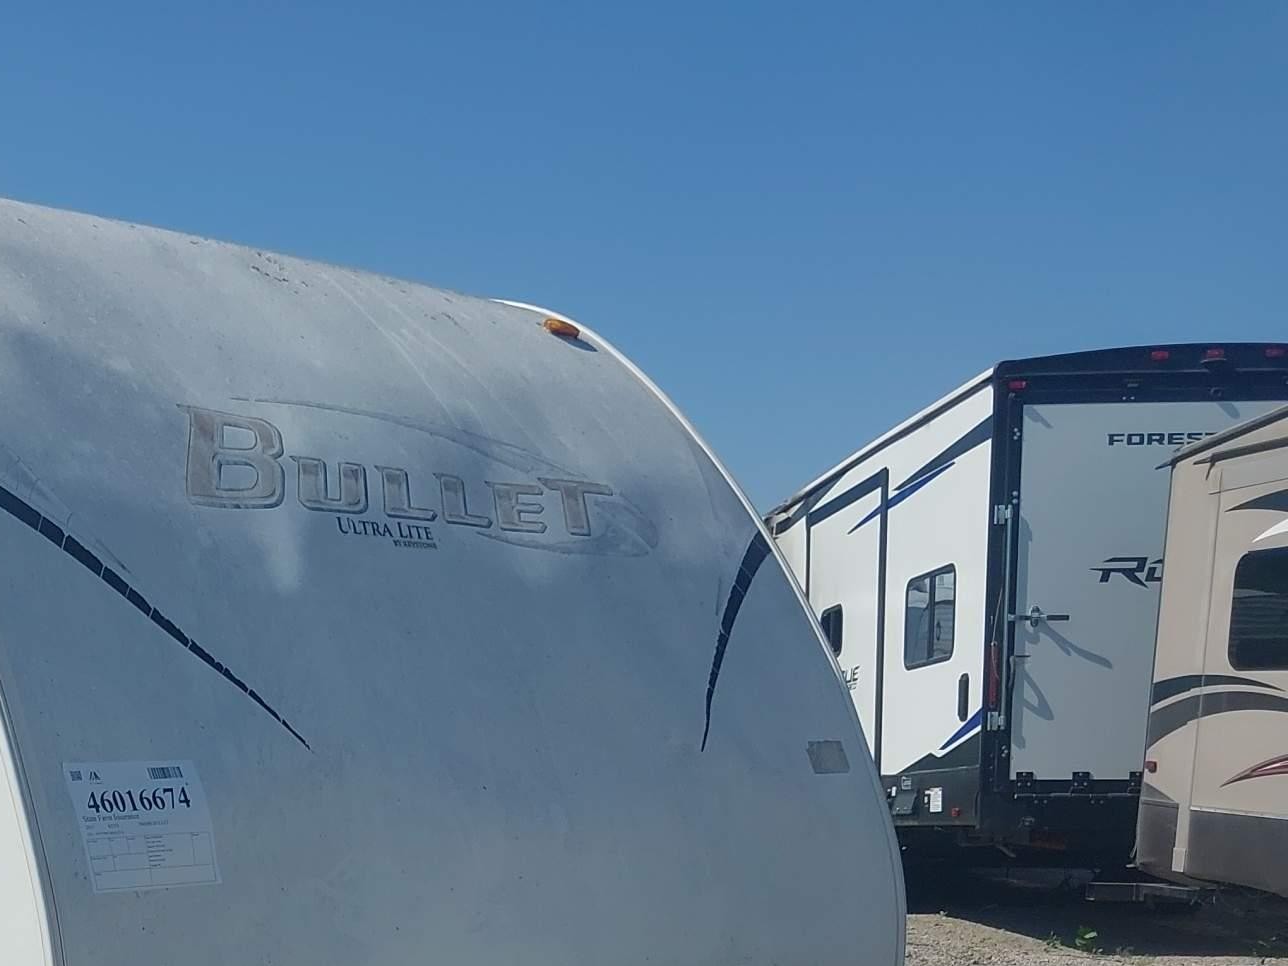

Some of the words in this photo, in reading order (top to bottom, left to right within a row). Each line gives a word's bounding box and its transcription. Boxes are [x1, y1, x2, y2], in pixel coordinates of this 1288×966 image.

[1107, 432, 1218, 446] FORES
[177, 403, 614, 536] BULLET
[337, 516, 393, 538] ULTRA
[397, 521, 434, 541] LITE
[87, 786, 191, 813] 46016674
